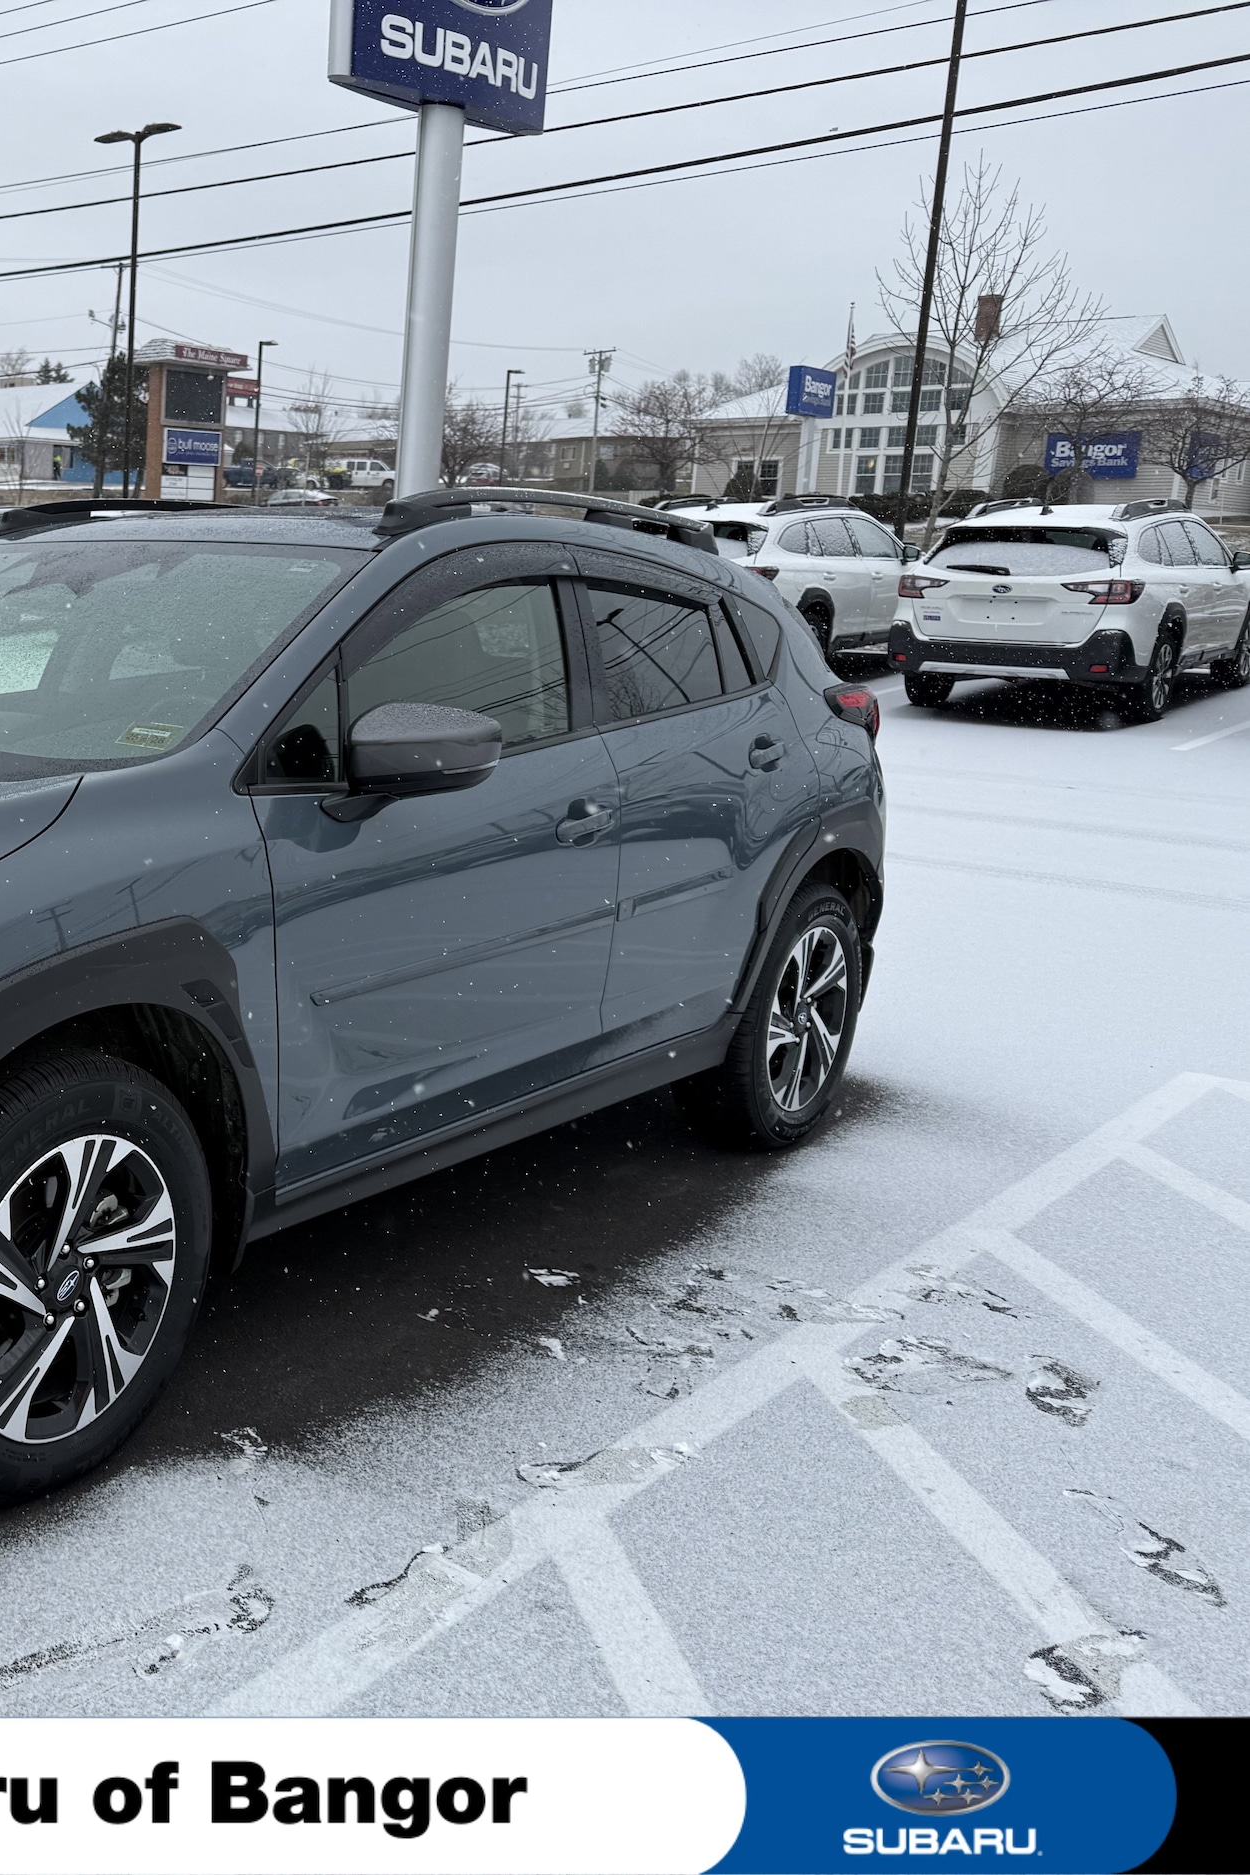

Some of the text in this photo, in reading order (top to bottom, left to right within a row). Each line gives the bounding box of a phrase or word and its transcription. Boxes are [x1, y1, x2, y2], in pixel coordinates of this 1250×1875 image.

[379, 13, 538, 100] SUBARU
[182, 347, 196, 359] The
[804, 375, 832, 398] Bangor
[177, 438, 219, 451] bull moose
[1051, 456, 1128, 469] Savigs Bank
[807, 901, 846, 922] GENERAL
